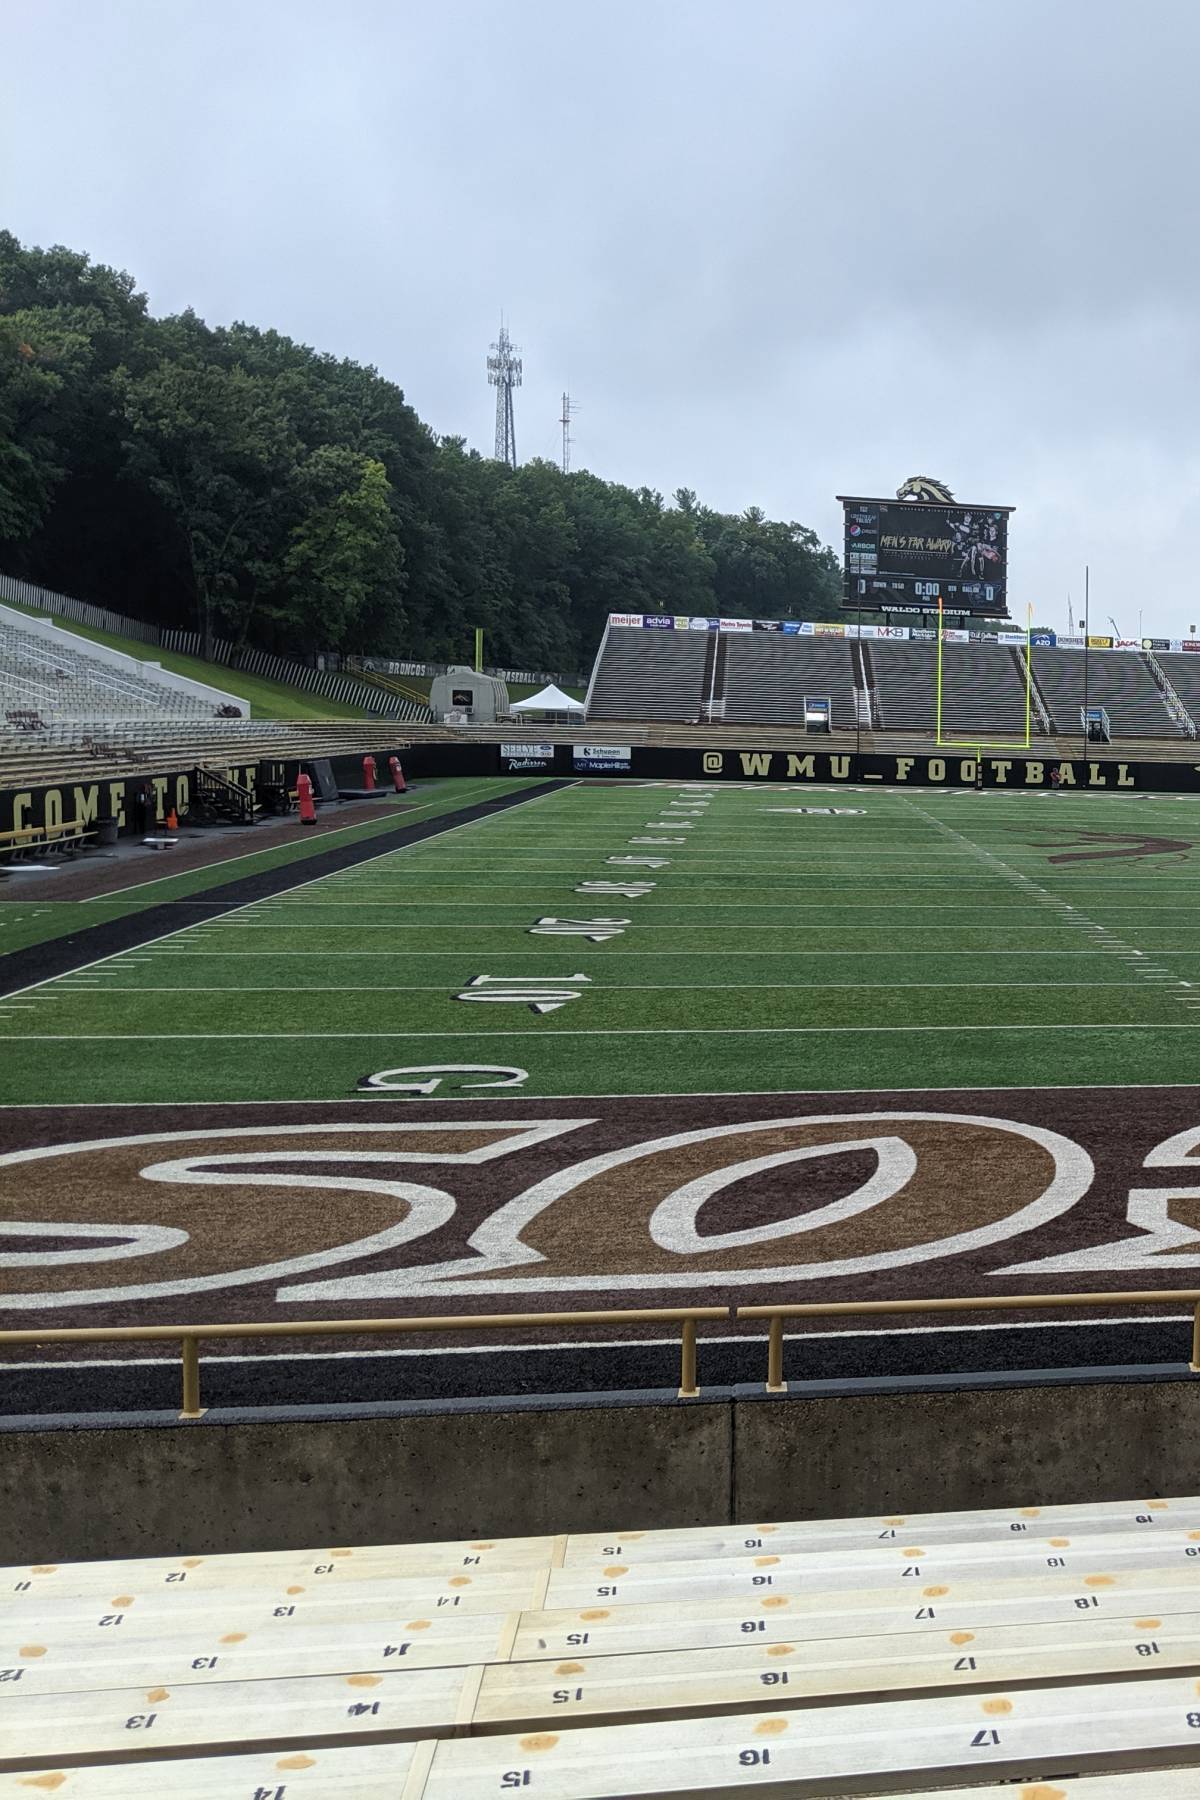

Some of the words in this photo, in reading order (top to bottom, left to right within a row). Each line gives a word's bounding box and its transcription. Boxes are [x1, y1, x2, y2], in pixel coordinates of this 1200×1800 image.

[915, 582, 940, 596] 0:00
[881, 605, 920, 613] WALDO
[923, 608, 971, 616] STADIUM
[611, 615, 641, 626] meijer
[646, 616, 671, 625] advia
[877, 626, 904, 637] MKB
[388, 662, 426, 677] BRONCOS
[152, 775, 190, 820] TO
[528, 917, 633, 936] 20
[457, 973, 593, 1002] 10
[356, 1064, 530, 1094] 5
[1135, 1514, 1154, 1524] 19
[1009, 1523, 1027, 1532] 18
[877, 1529, 897, 1540] 17
[744, 1538, 763, 1549] 16
[602, 1546, 623, 1557] 15
[463, 1556, 480, 1565] 14
[1046, 1557, 1066, 1568] 18
[313, 1563, 335, 1575] 13
[901, 1566, 921, 1577] 17
[165, 1571, 187, 1583] 12
[751, 1575, 773, 1586] 16
[15, 1582, 31, 1591] 11
[596, 1585, 617, 1597] 15
[437, 1595, 461, 1606] 14
[1073, 1596, 1099, 1609] 18
[272, 1605, 296, 1617] 13
[914, 1607, 936, 1620] 17
[97, 1614, 124, 1627] 12
[740, 1620, 766, 1634] 16
[566, 1632, 589, 1646] 15
[383, 1642, 412, 1658] 14
[1134, 1641, 1160, 1655] 18
[191, 1656, 219, 1670] 13
[954, 1656, 977, 1671] 17
[759, 1671, 789, 1686] 16
[552, 1687, 583, 1704] 15
[347, 1701, 381, 1717] 14
[124, 1713, 158, 1730] 13
[969, 1729, 1001, 1748] 17
[738, 1748, 771, 1767] 16
[499, 1769, 532, 1789] 15
